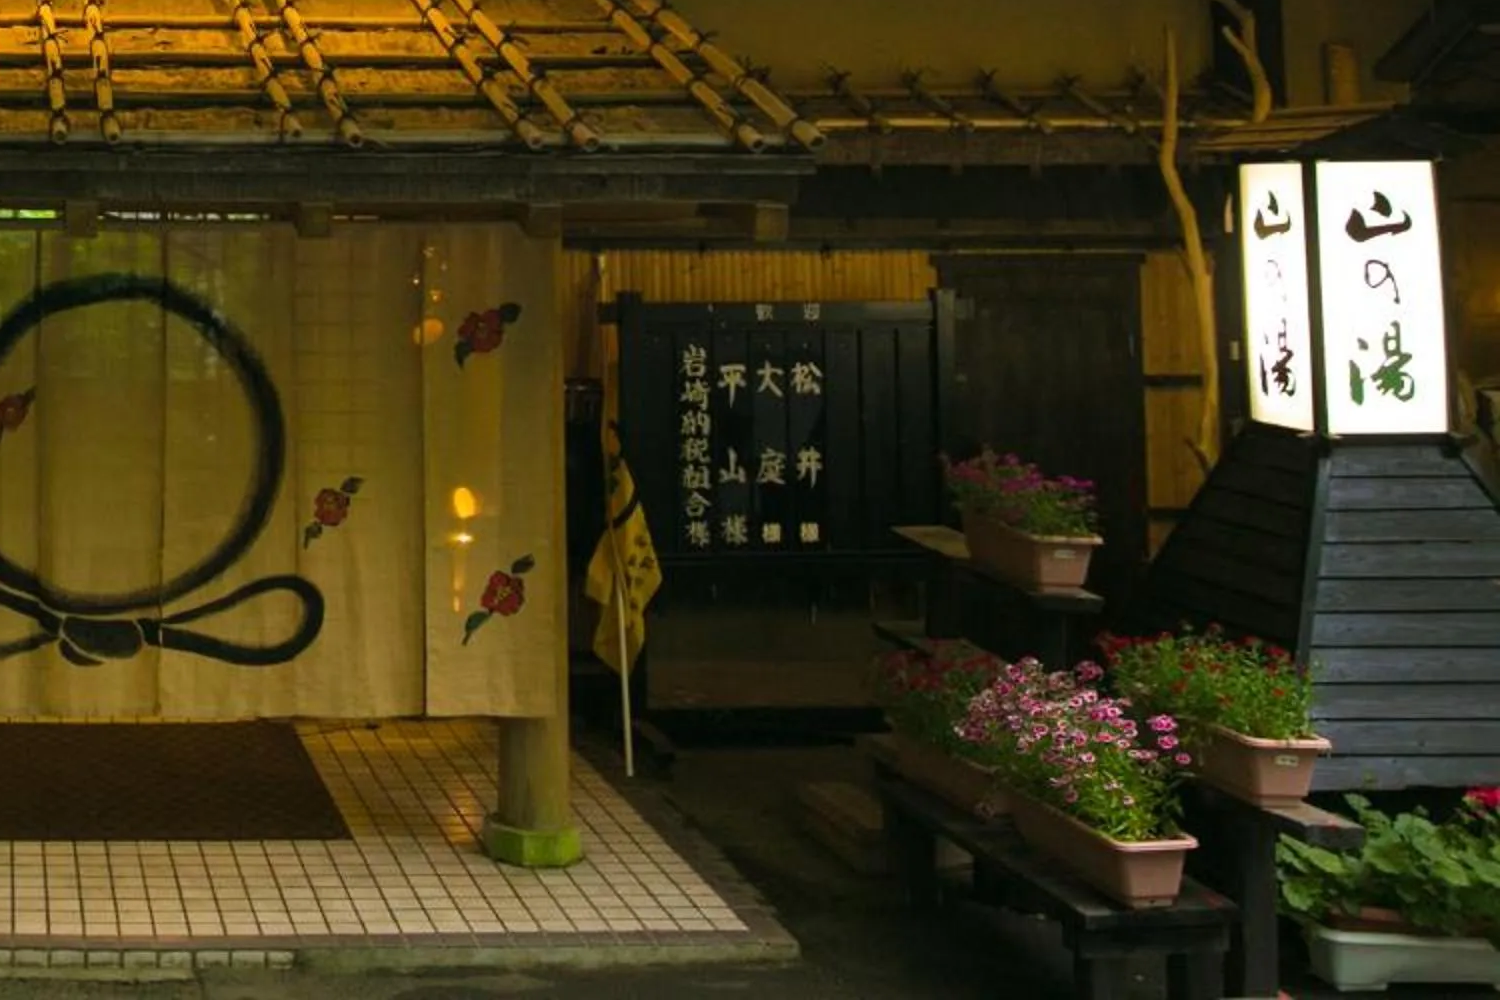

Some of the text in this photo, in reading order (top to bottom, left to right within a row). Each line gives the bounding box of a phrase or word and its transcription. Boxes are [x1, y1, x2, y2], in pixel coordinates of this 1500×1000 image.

[1254, 190, 1296, 396] 山の湯
[1345, 190, 1415, 406] 山の湯
[717, 363, 748, 546] 平山様
